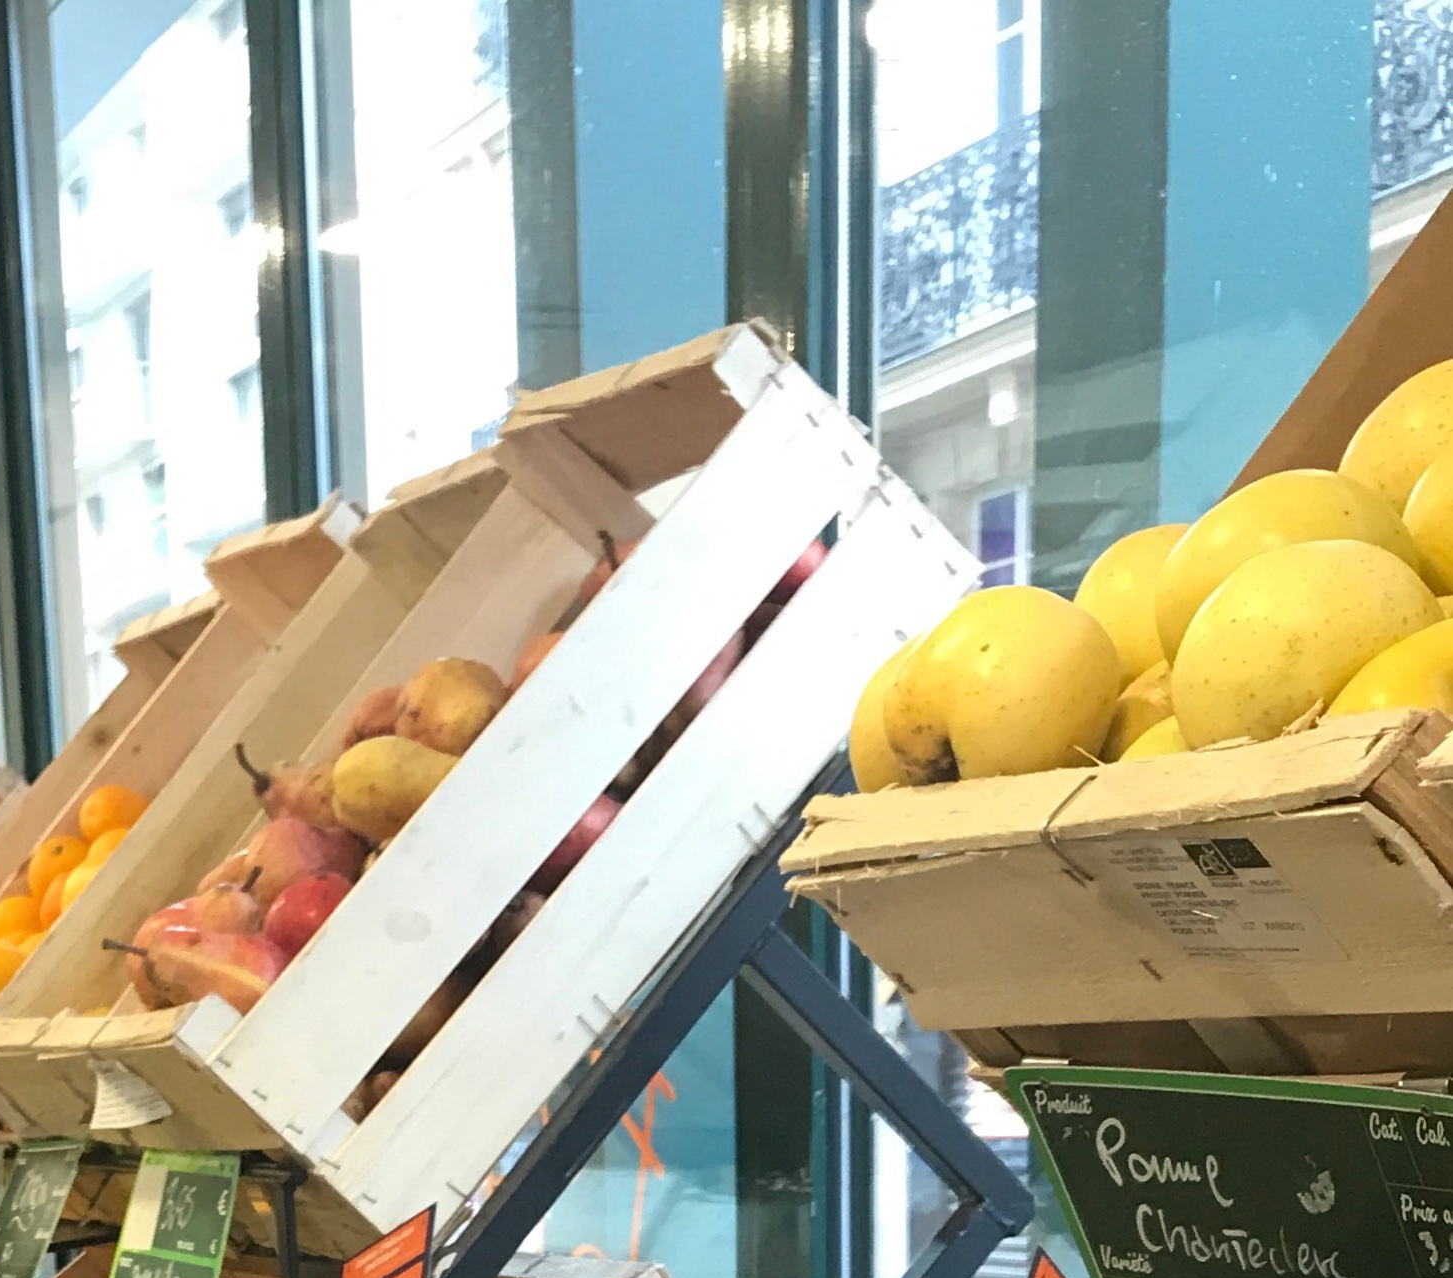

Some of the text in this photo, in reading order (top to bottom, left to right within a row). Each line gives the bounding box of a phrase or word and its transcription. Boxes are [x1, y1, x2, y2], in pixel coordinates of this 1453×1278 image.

[1034, 1089, 1093, 1115] Produit
[1369, 1111, 1403, 1142] Cat.
[1416, 1116, 1451, 1147] Cal.
[1399, 1193, 1453, 1225] Prix a
[1100, 1244, 1153, 1274] Variété
